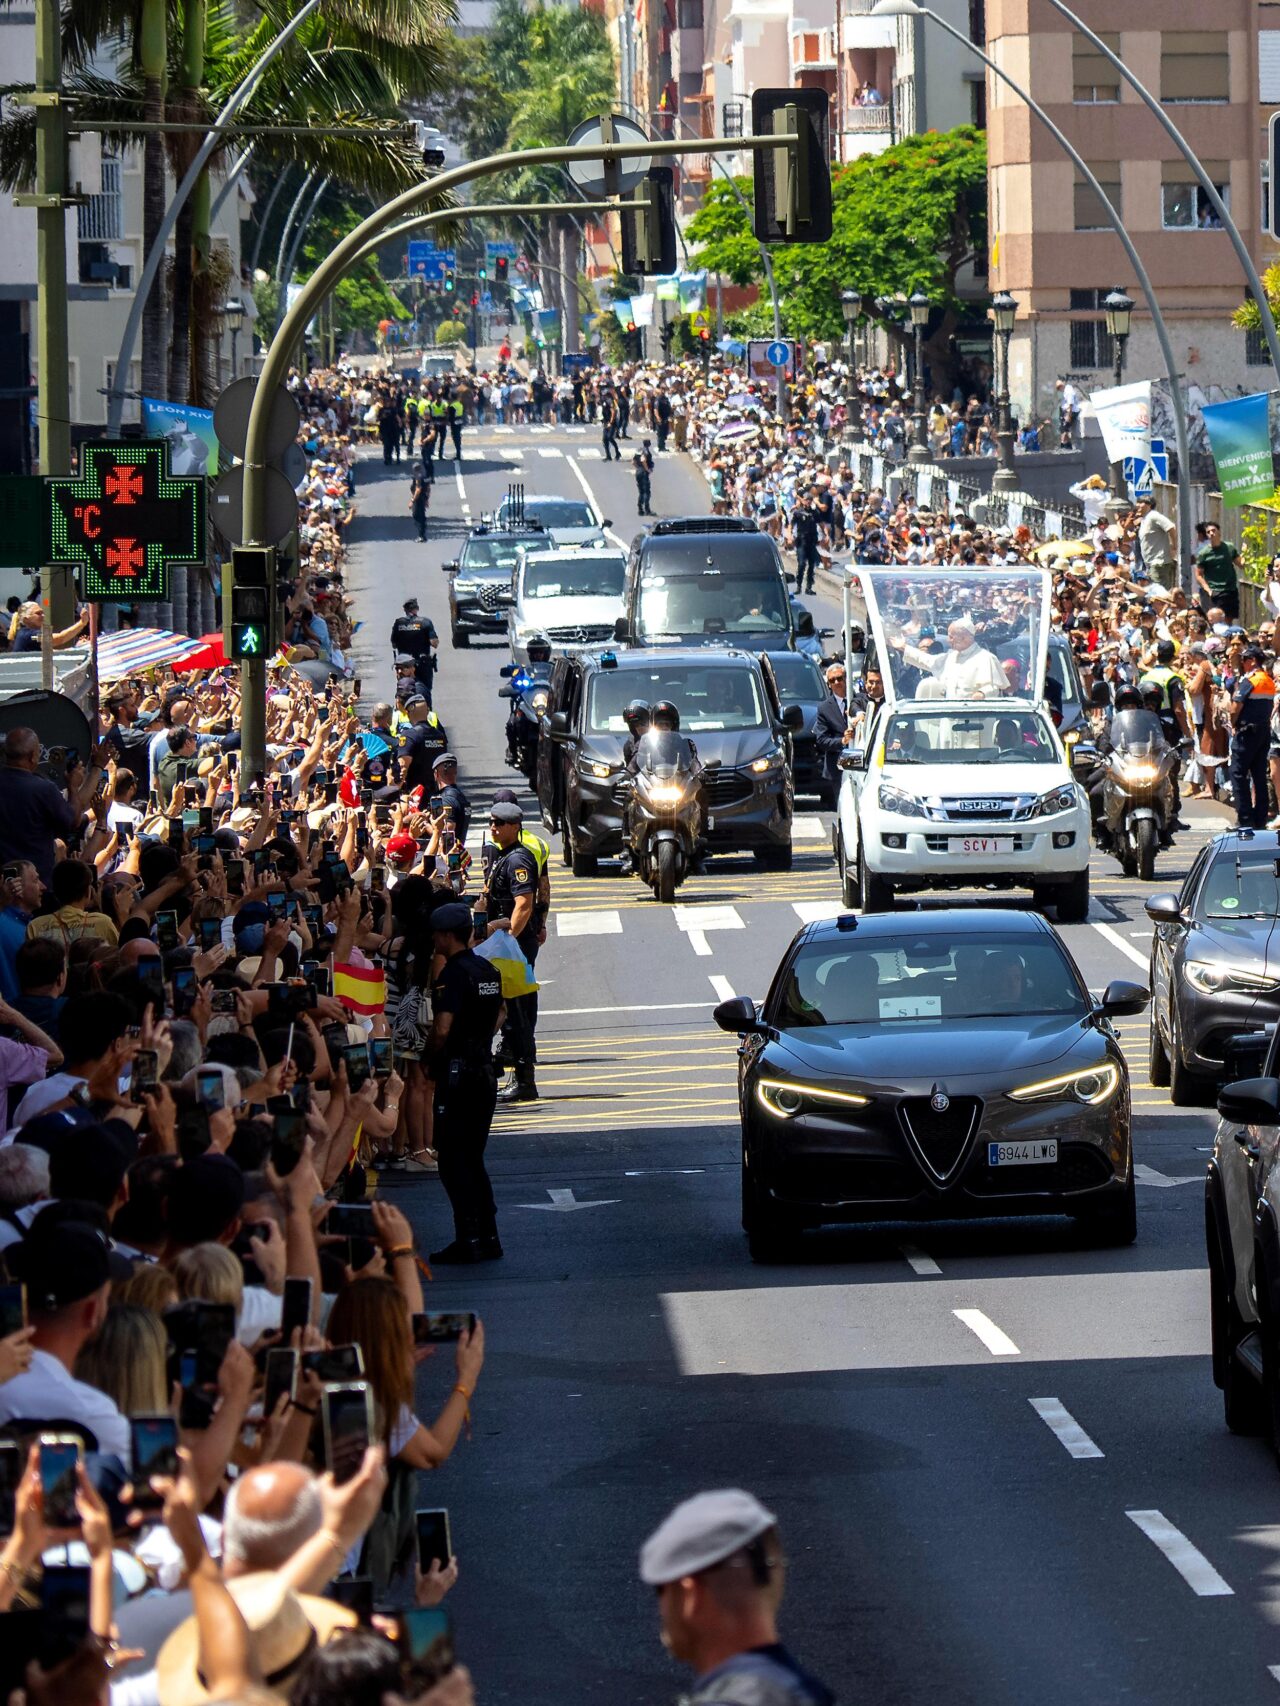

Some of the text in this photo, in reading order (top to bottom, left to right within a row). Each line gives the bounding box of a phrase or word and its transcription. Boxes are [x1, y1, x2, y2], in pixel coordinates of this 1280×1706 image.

[1218, 451, 1271, 469] BIENVENIDO
[1224, 472, 1273, 491] SANTACR
[961, 801, 1000, 810] ISUZU
[964, 840, 998, 852] SCV 1
[998, 1147, 1029, 1160] 6944
